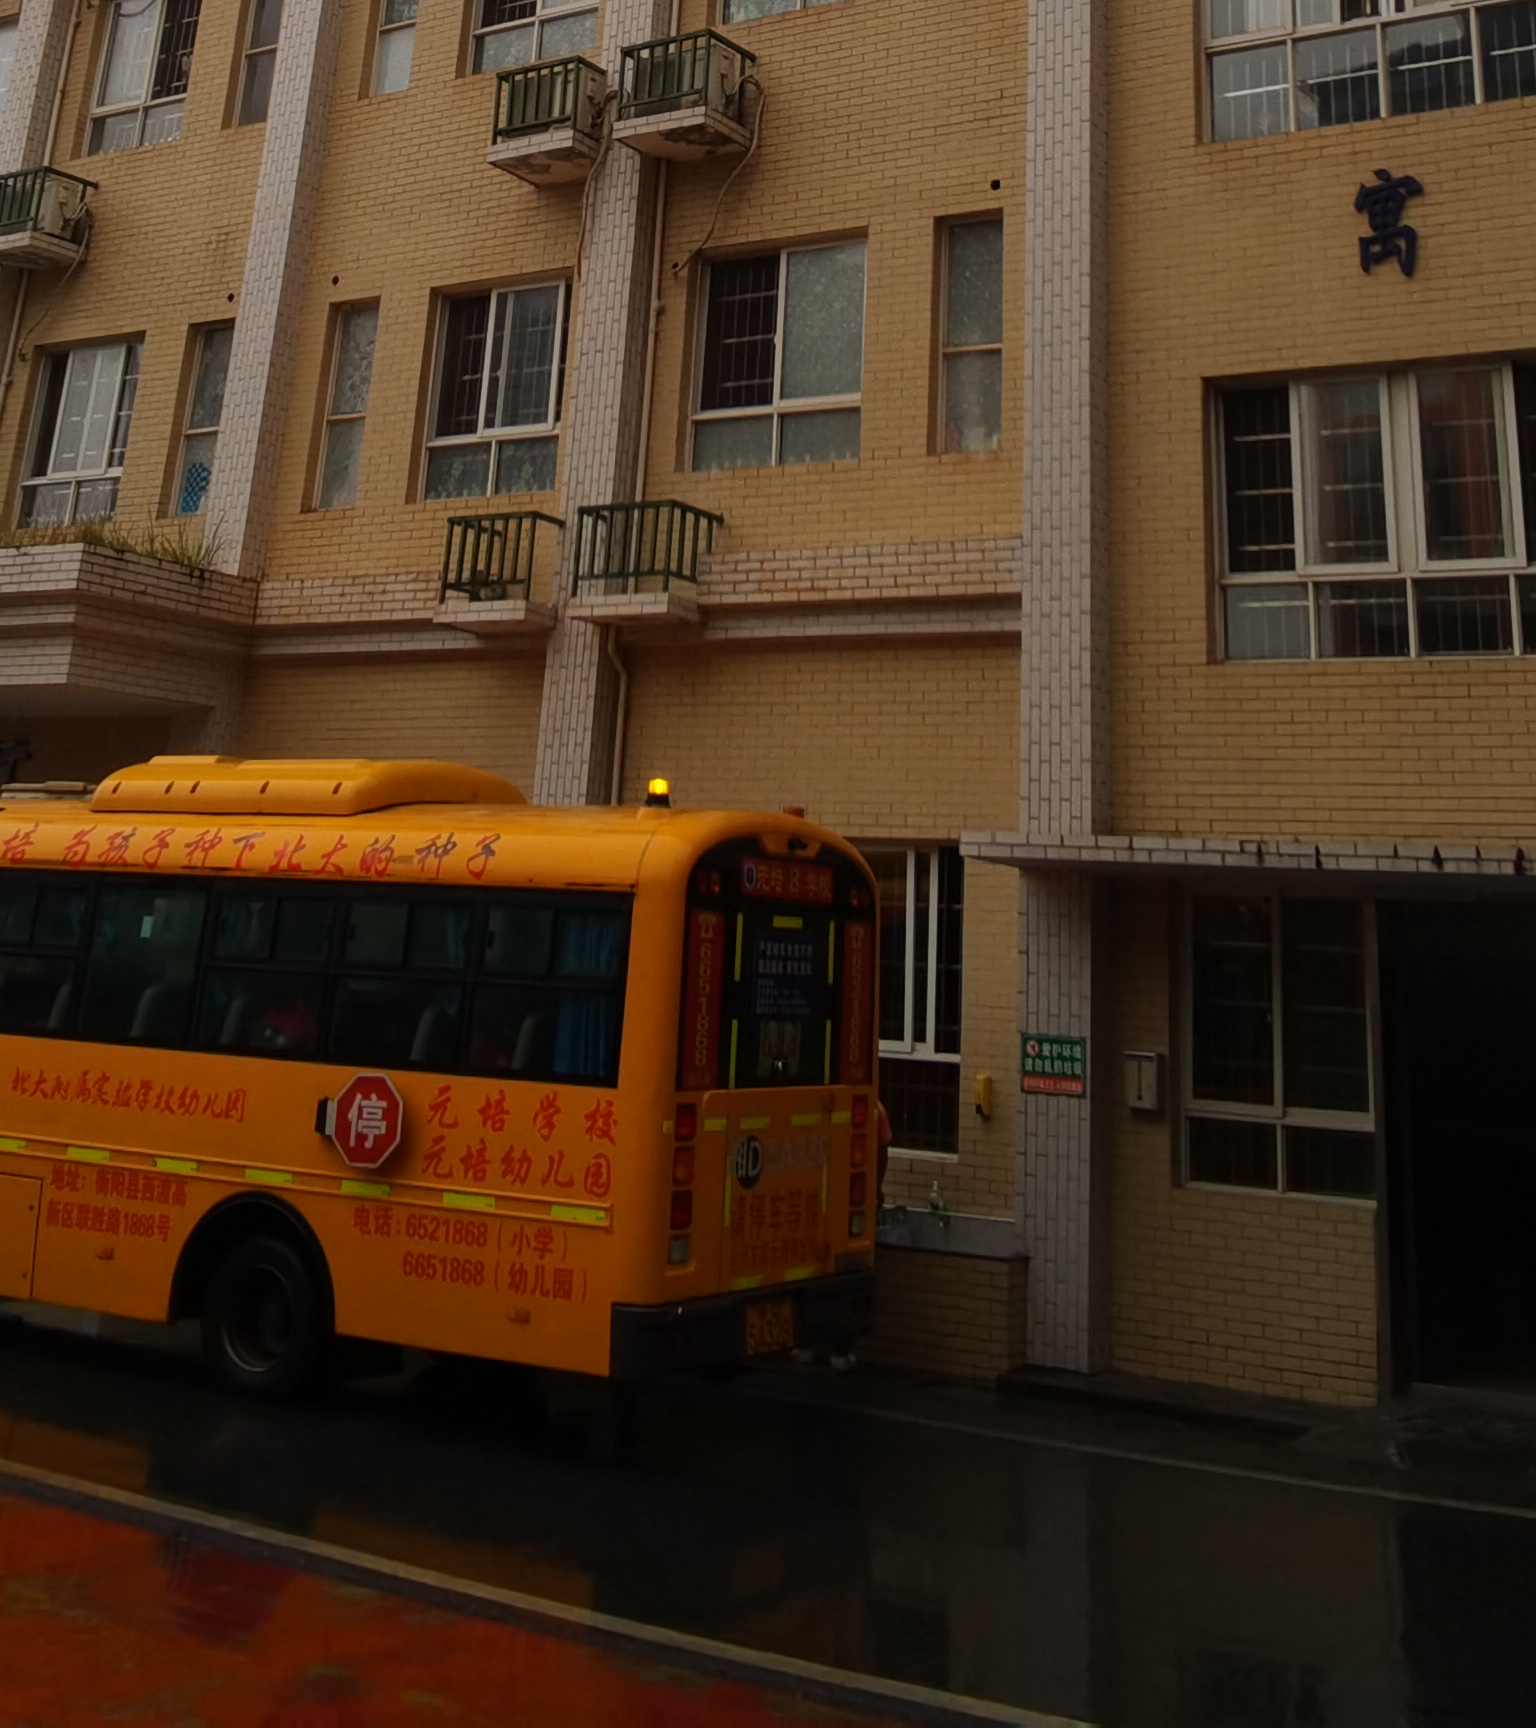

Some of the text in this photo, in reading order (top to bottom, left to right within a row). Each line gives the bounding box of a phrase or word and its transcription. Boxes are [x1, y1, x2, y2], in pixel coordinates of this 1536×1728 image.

[347, 1092, 388, 1149] 停
[427, 1084, 619, 1147] 元培学校
[421, 1133, 613, 1199] 元培幼儿园
